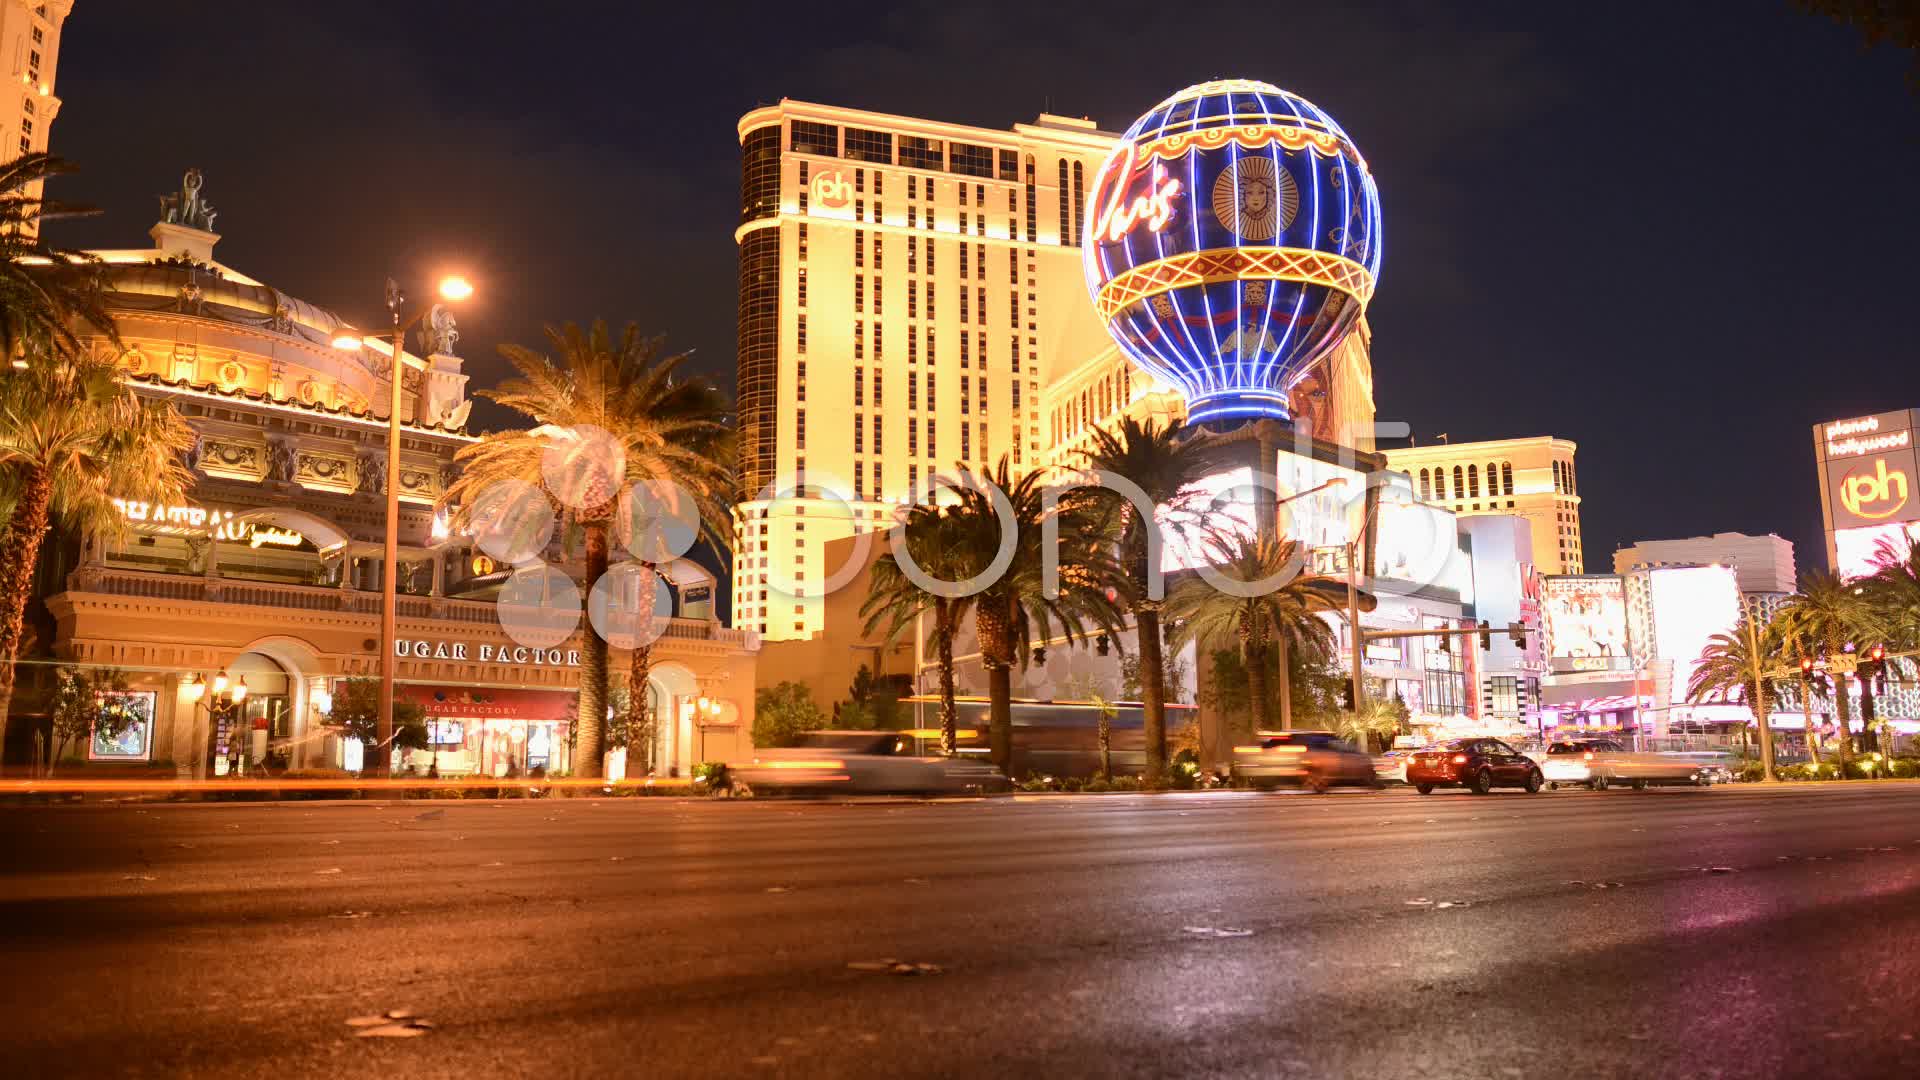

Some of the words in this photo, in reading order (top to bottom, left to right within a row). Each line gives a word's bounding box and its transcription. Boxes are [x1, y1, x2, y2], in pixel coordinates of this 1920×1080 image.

[815, 171, 853, 208] ph
[1826, 417, 1879, 441] planet
[1827, 430, 1909, 457] hollywood
[1845, 458, 1908, 515] ph
[395, 640, 467, 661] UGAR
[479, 644, 582, 667] FACTOR
[424, 704, 457, 714] UGAR
